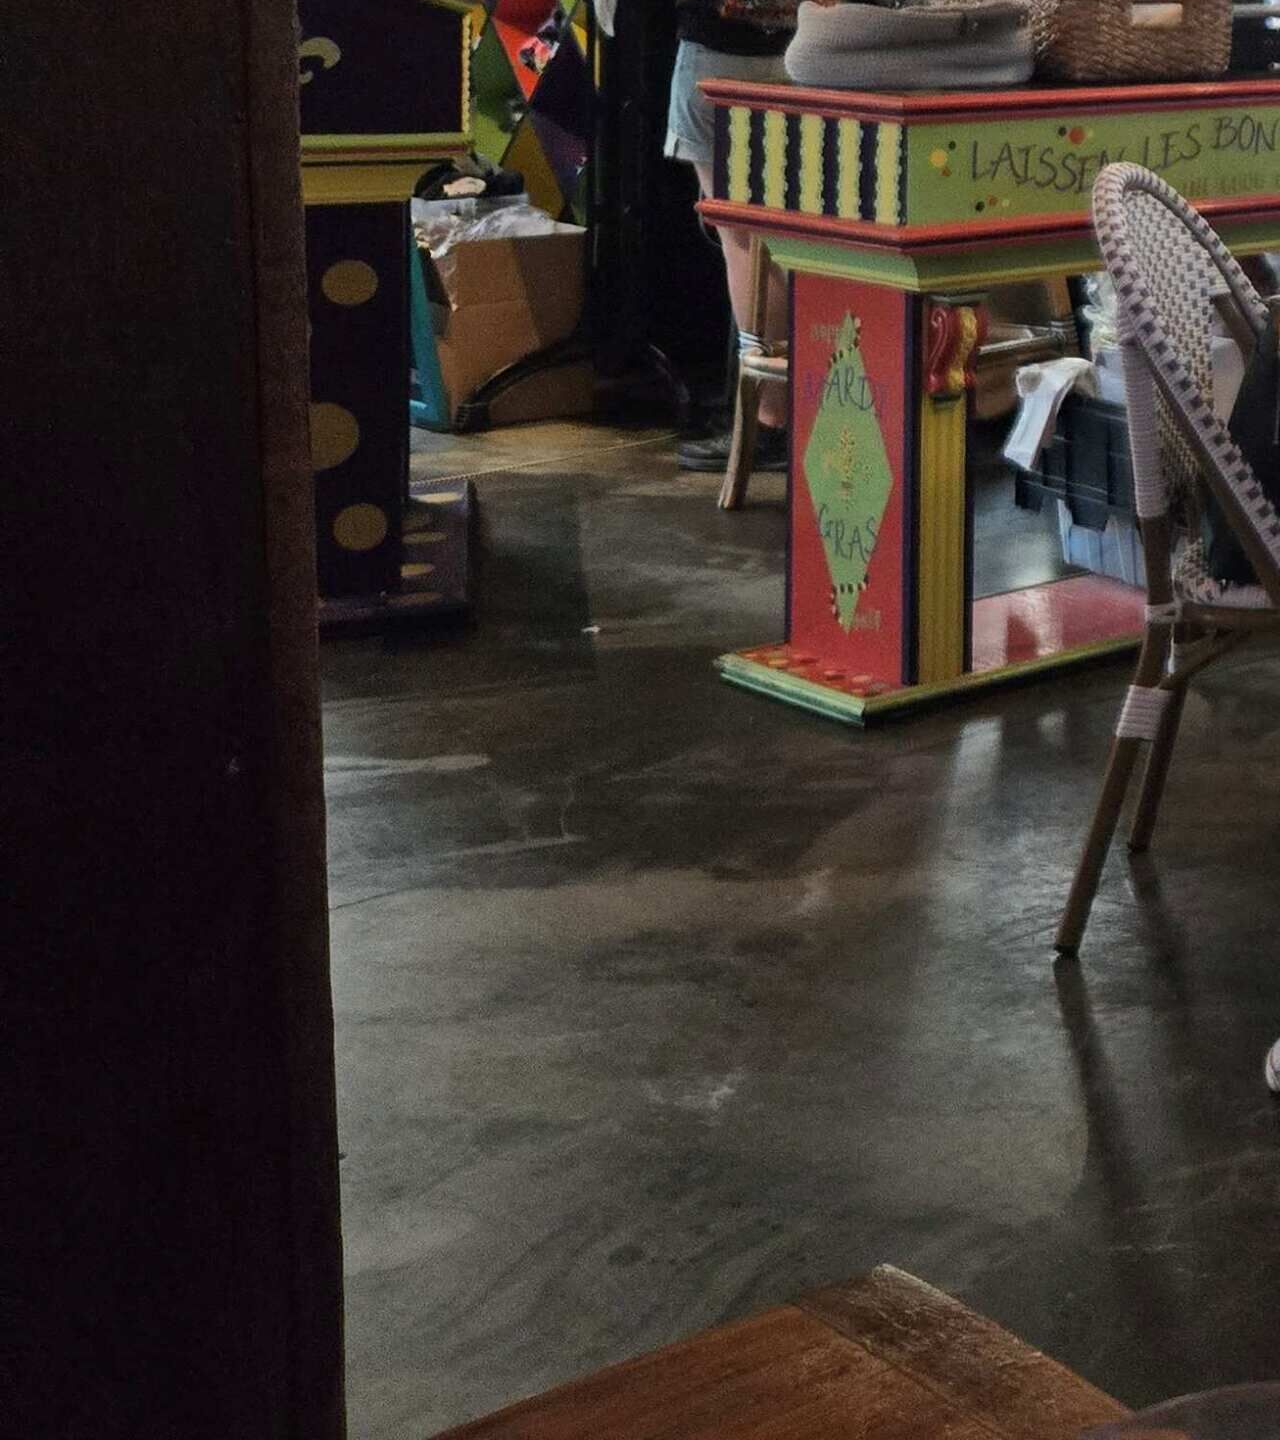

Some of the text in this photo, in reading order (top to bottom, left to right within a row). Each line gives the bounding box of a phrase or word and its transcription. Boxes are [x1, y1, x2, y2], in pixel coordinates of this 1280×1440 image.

[1145, 124, 1201, 172] LES
[1211, 114, 1277, 156] BON
[819, 503, 880, 564] GRAS
